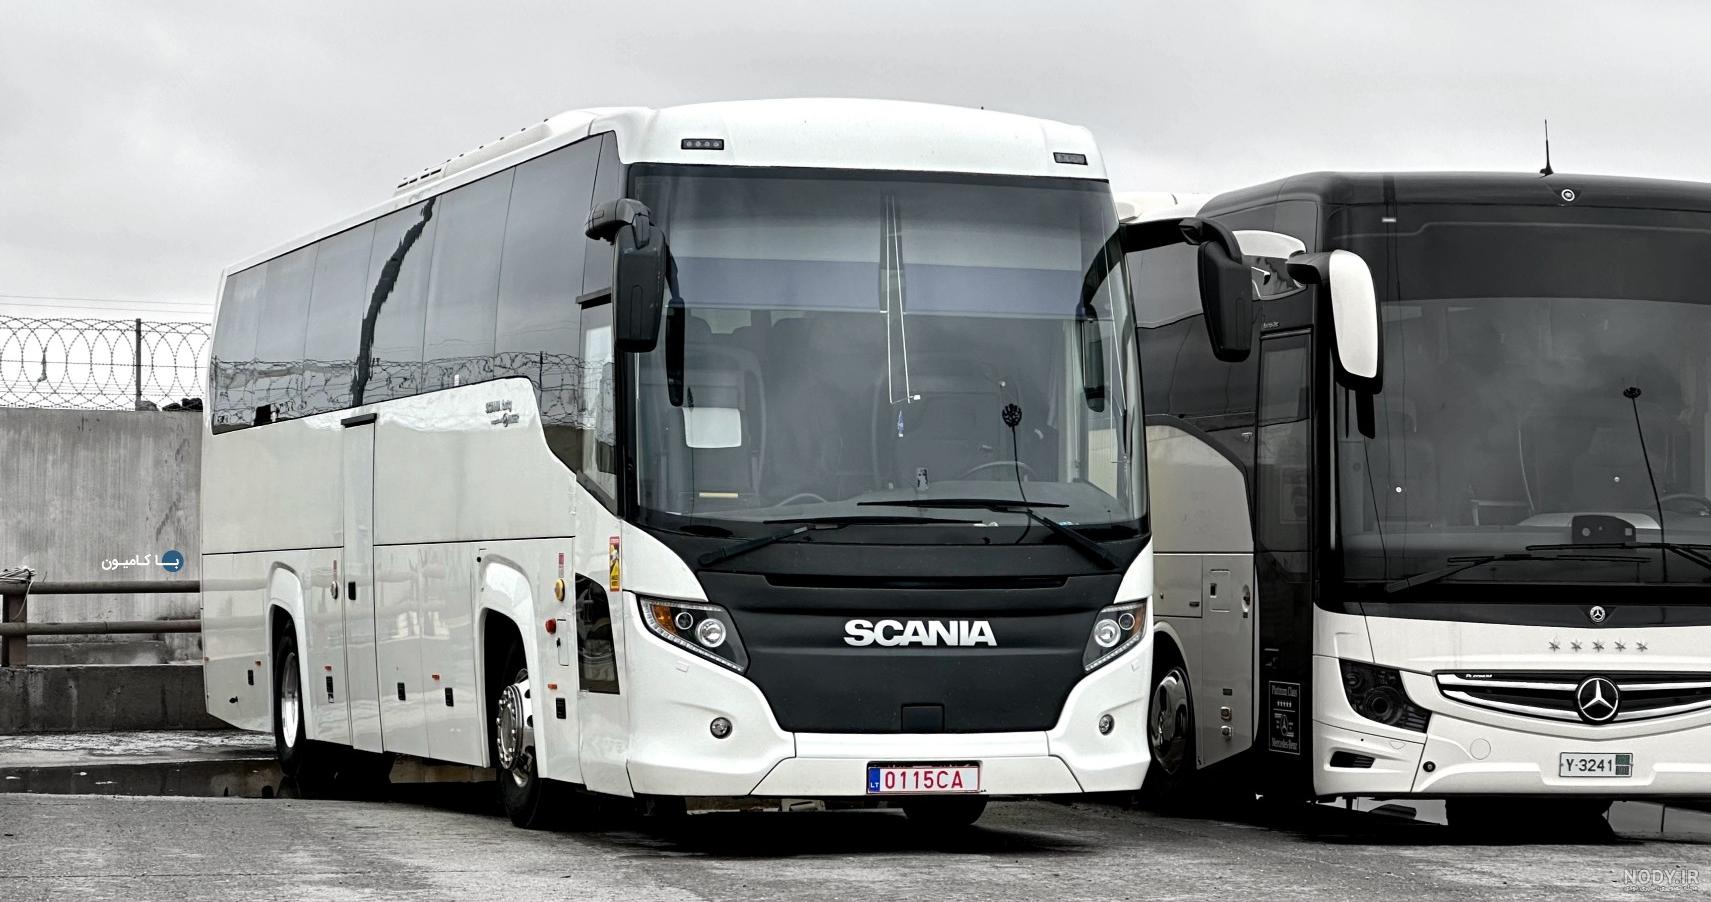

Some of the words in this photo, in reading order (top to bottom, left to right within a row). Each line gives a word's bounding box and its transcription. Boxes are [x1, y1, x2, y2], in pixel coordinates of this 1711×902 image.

[843, 619, 998, 647] SCANIA
[1566, 758, 1612, 772] Y-3241
[885, 770, 963, 789] 0115CA
